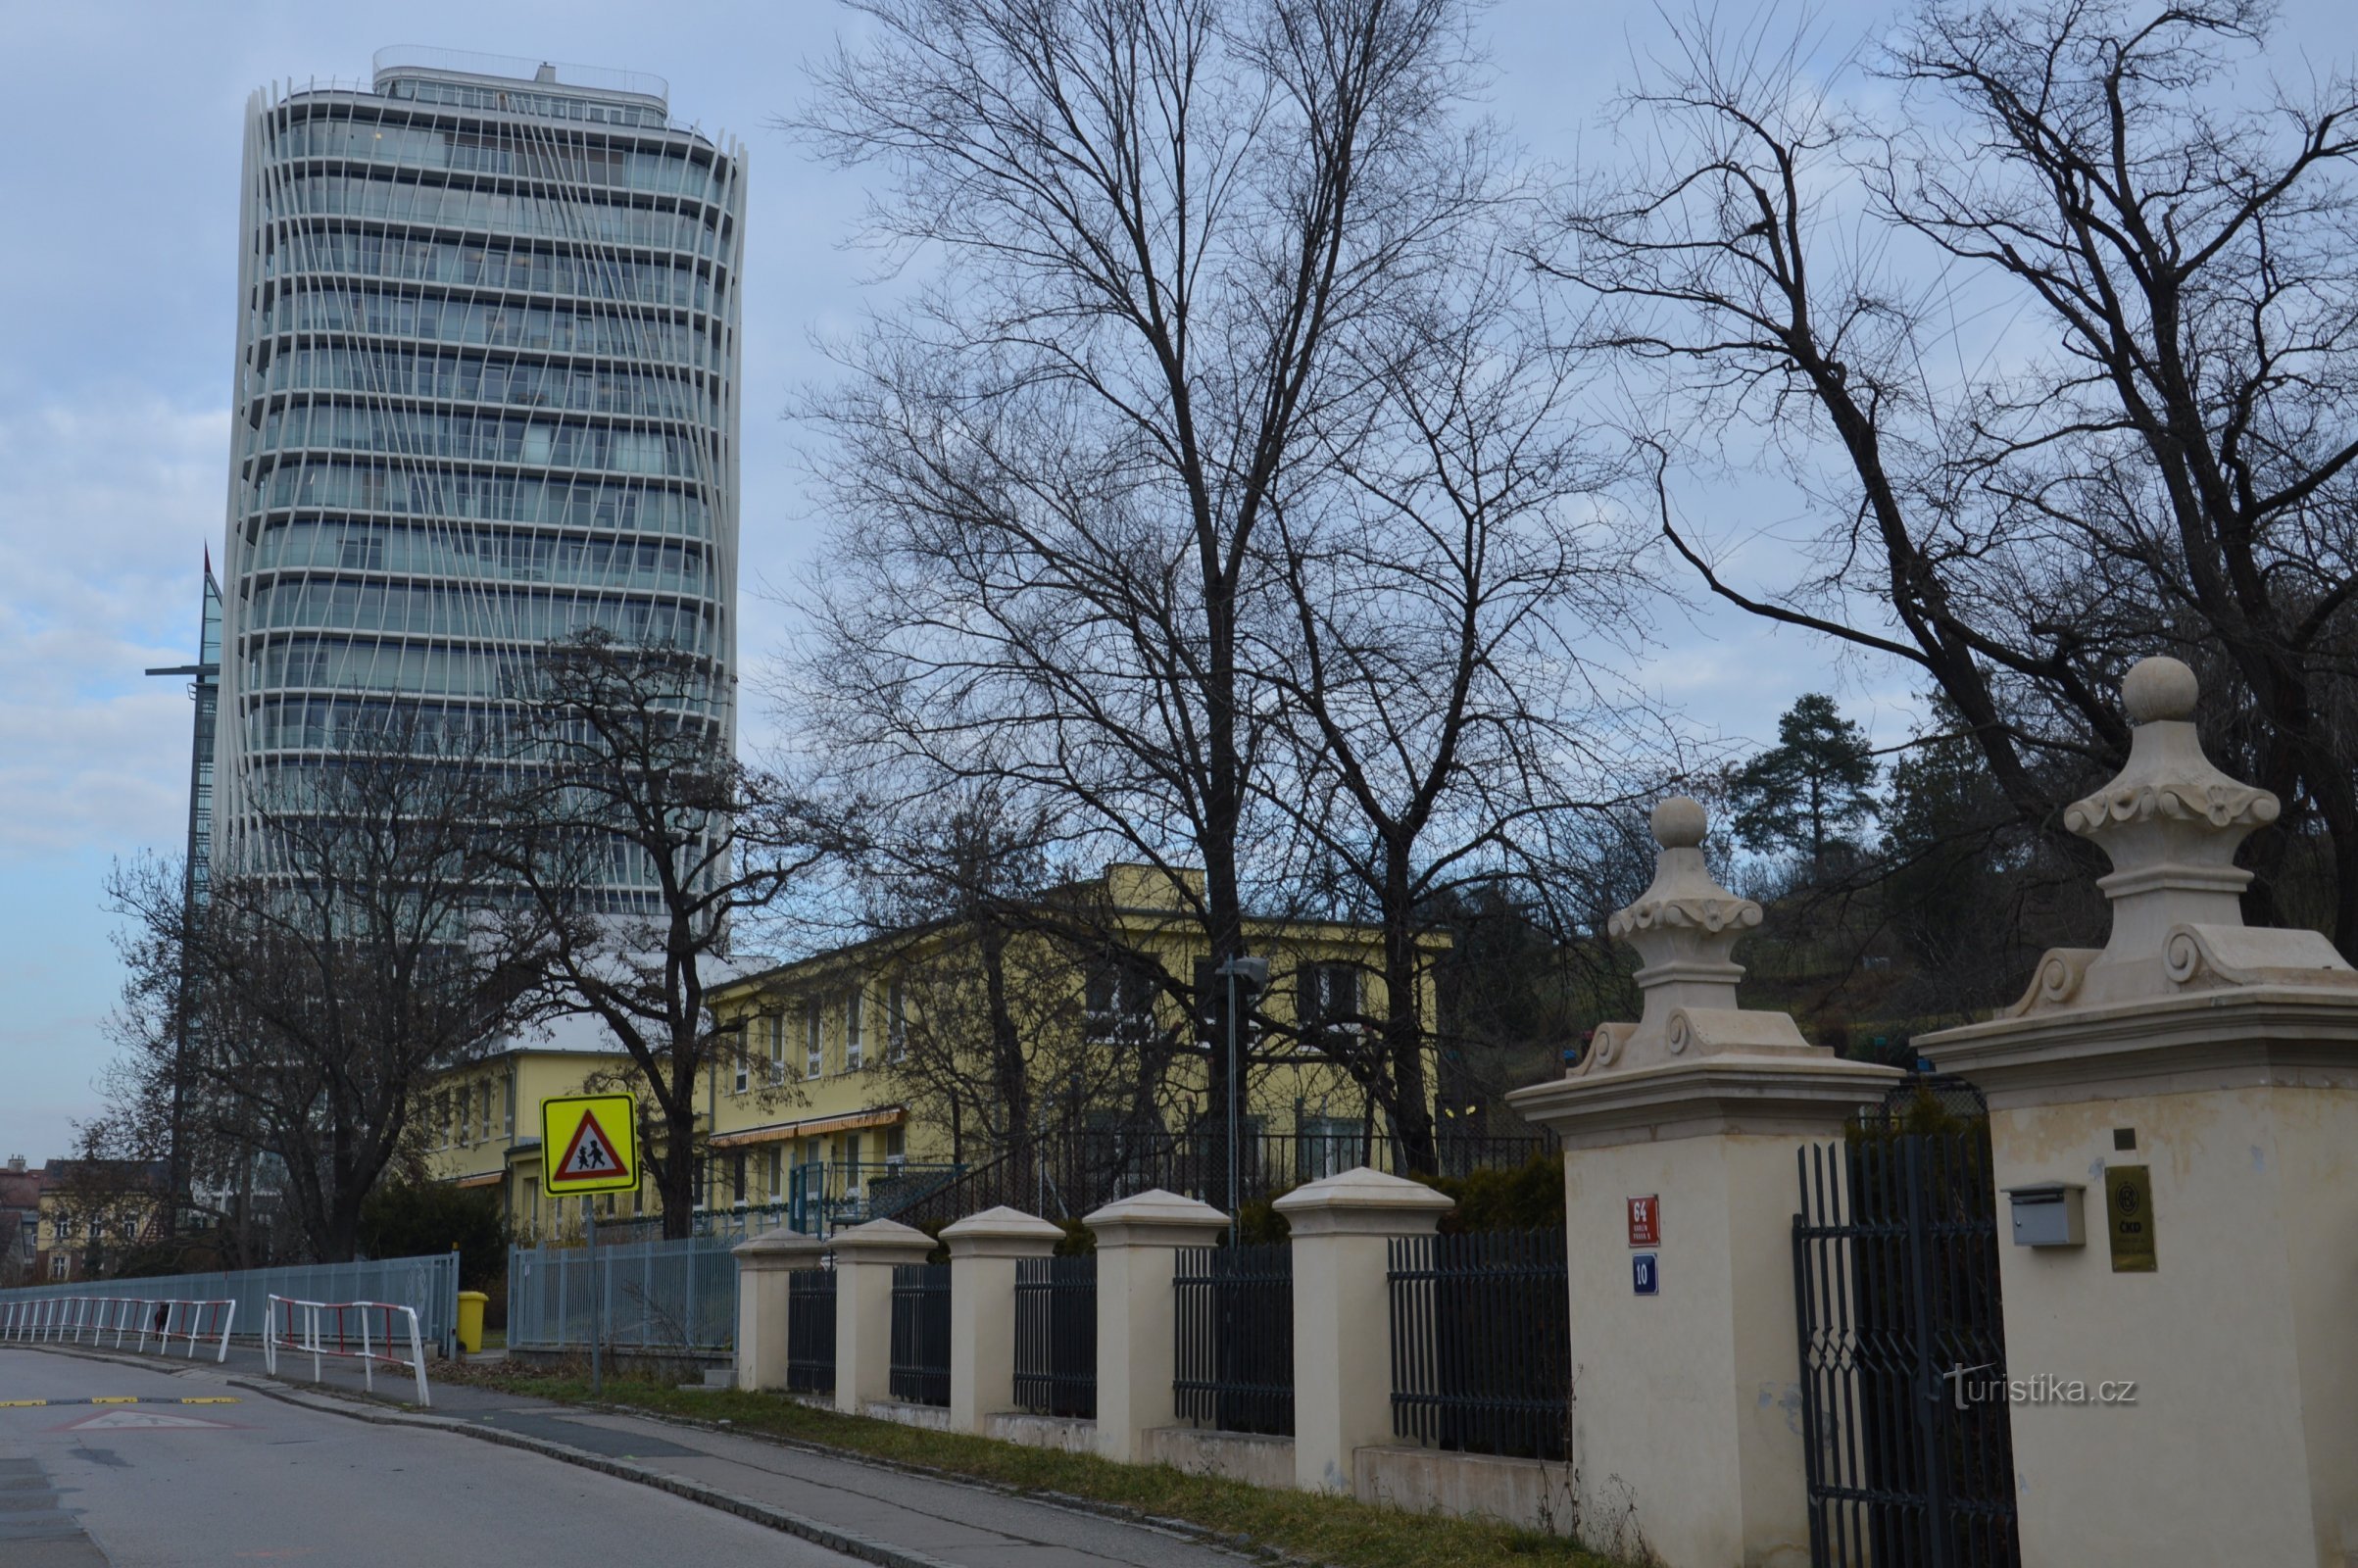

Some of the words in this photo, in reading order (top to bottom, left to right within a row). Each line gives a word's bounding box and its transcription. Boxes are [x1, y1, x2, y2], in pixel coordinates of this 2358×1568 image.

[1634, 1201, 1646, 1222] 64
[2119, 1220, 2141, 1234] ČKD
[1637, 1263, 1647, 1285] 10
